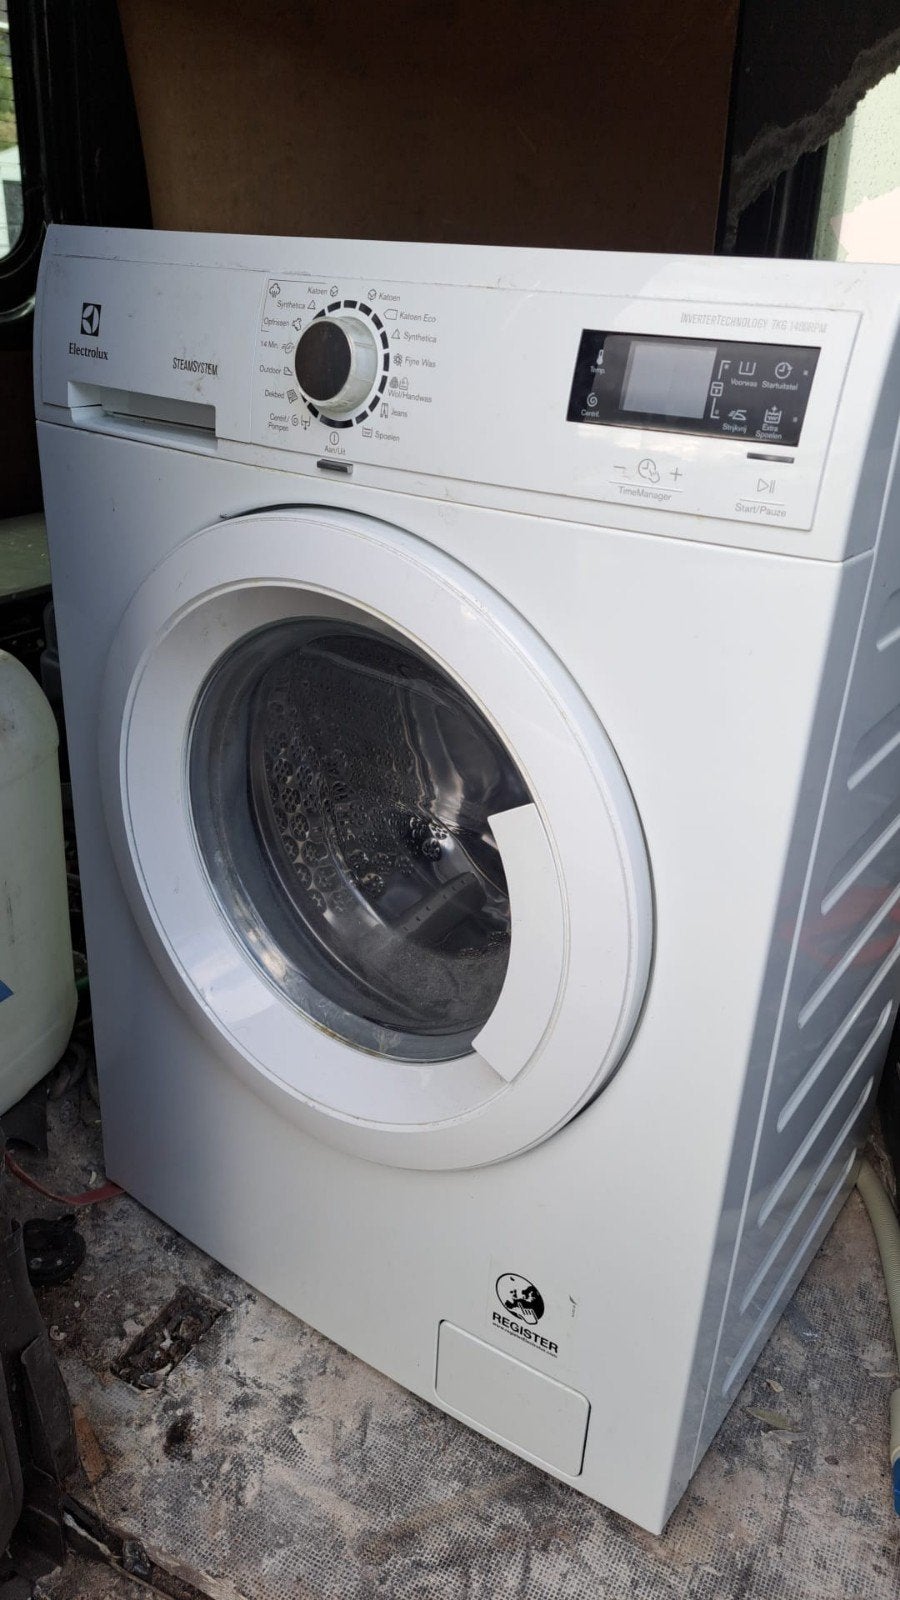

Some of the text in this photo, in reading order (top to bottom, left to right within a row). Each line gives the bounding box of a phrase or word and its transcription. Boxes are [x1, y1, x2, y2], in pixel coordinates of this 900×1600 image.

[307, 286, 328, 295] Katoen
[378, 291, 401, 301] Katoen
[276, 299, 306, 310] Synthetica
[400, 311, 437, 323] Katoen Eco
[680, 312, 767, 329] INVERTERTECHNOLOGY
[404, 331, 437, 343] Synthetica
[68, 342, 109, 361] Electrolux
[172, 357, 218, 376] STEAMSYSTEM
[259, 364, 282, 374] Outdoor
[421, 358, 436, 368] Was
[730, 377, 758, 389] Voorwas
[761, 380, 799, 391] Startuitstel
[264, 389, 285, 399] Dekbed
[388, 388, 432, 404] Wol/Handwas
[391, 407, 408, 418] Jeans
[761, 423, 779, 433] Extra
[374, 430, 400, 442] Spoelen
[618, 485, 672, 502] TimeManager
[734, 502, 787, 518] Start/Pauze
[492, 1311, 559, 1354] REGISTER
